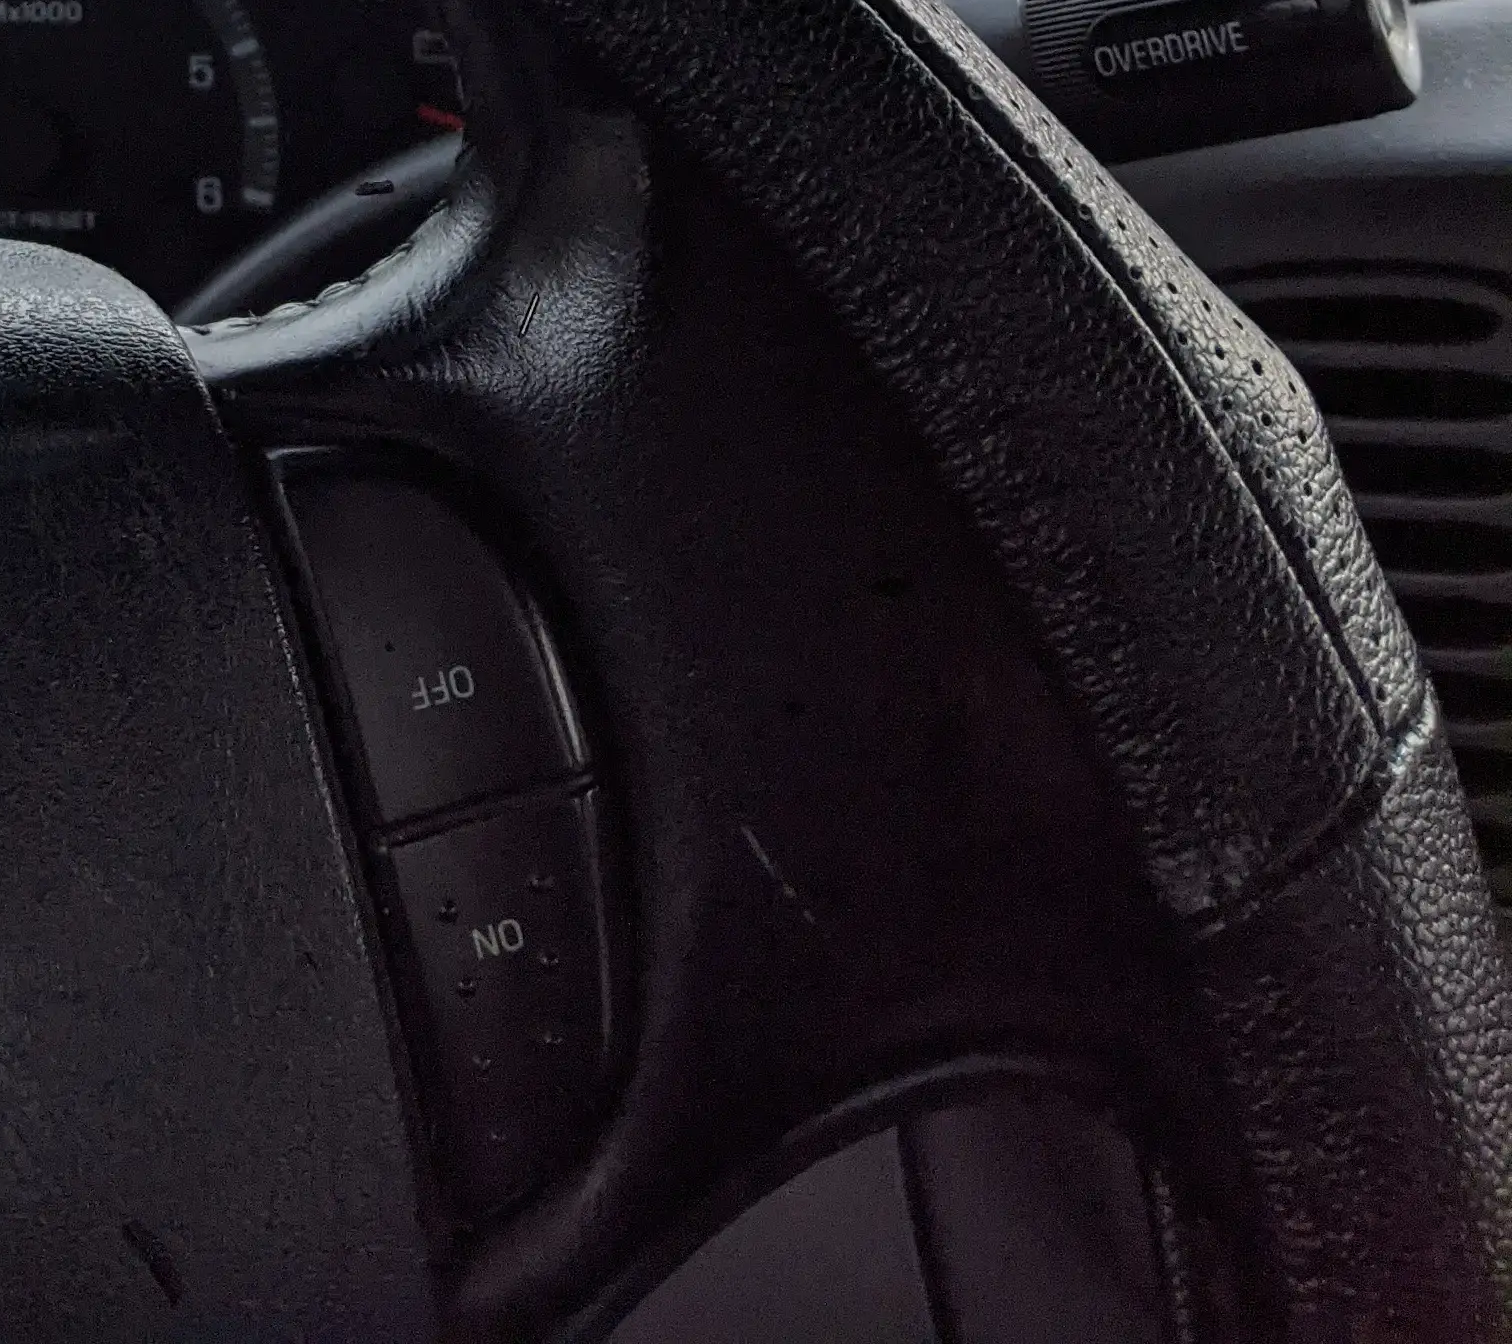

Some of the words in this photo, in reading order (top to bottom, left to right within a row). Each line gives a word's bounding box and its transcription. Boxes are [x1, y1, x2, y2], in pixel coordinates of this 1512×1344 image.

[1094, 21, 1248, 77] OVERDRIVE
[188, 54, 214, 88] 5
[196, 176, 223, 212] 6
[411, 665, 475, 711] OFF
[470, 918, 524, 960] ON
